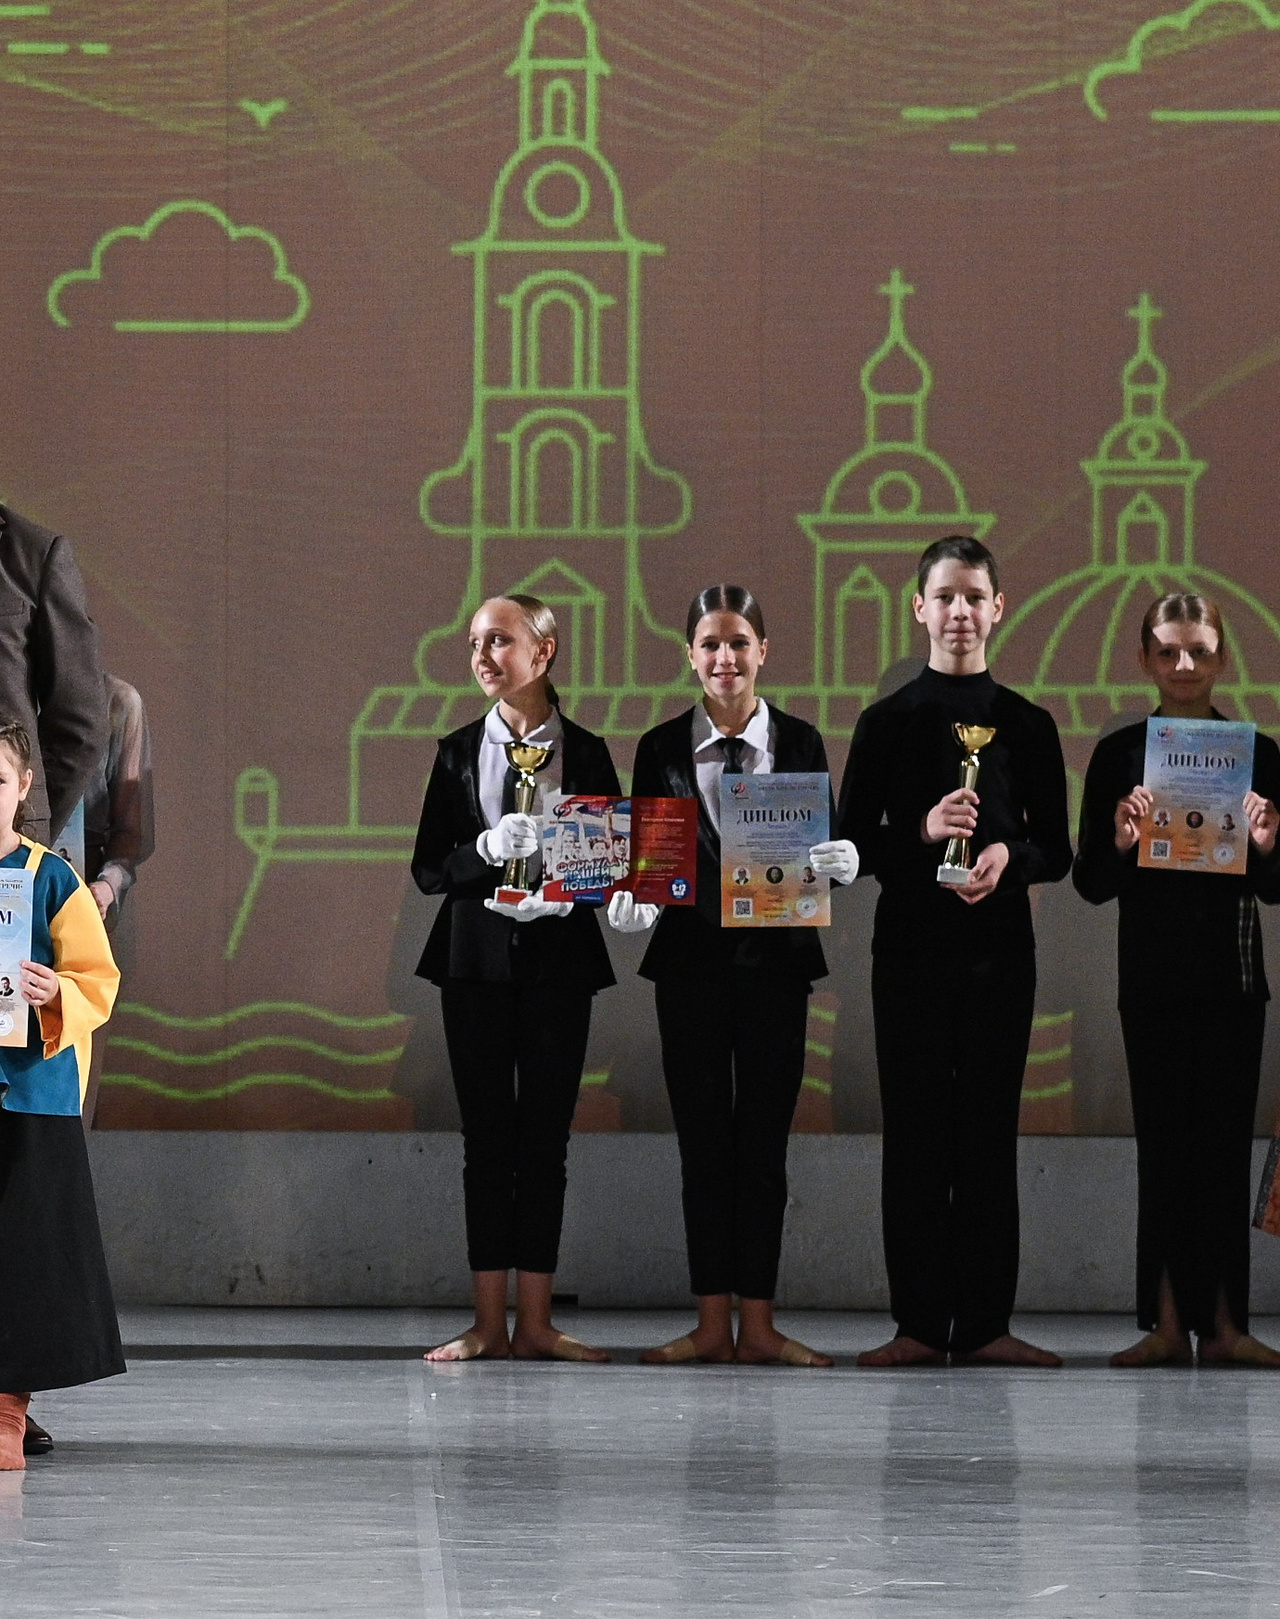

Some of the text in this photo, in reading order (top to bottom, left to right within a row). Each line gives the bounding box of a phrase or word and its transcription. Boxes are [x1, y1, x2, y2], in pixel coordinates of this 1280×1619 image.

[1160, 753, 1236, 770] ДИПЛОМ
[736, 809, 812, 825] ДИПЛОМ
[556, 859, 620, 873] ФОРМУЛА
[564, 866, 610, 882] НАШЕЙ
[561, 876, 615, 892] ПОБЕДЫ
